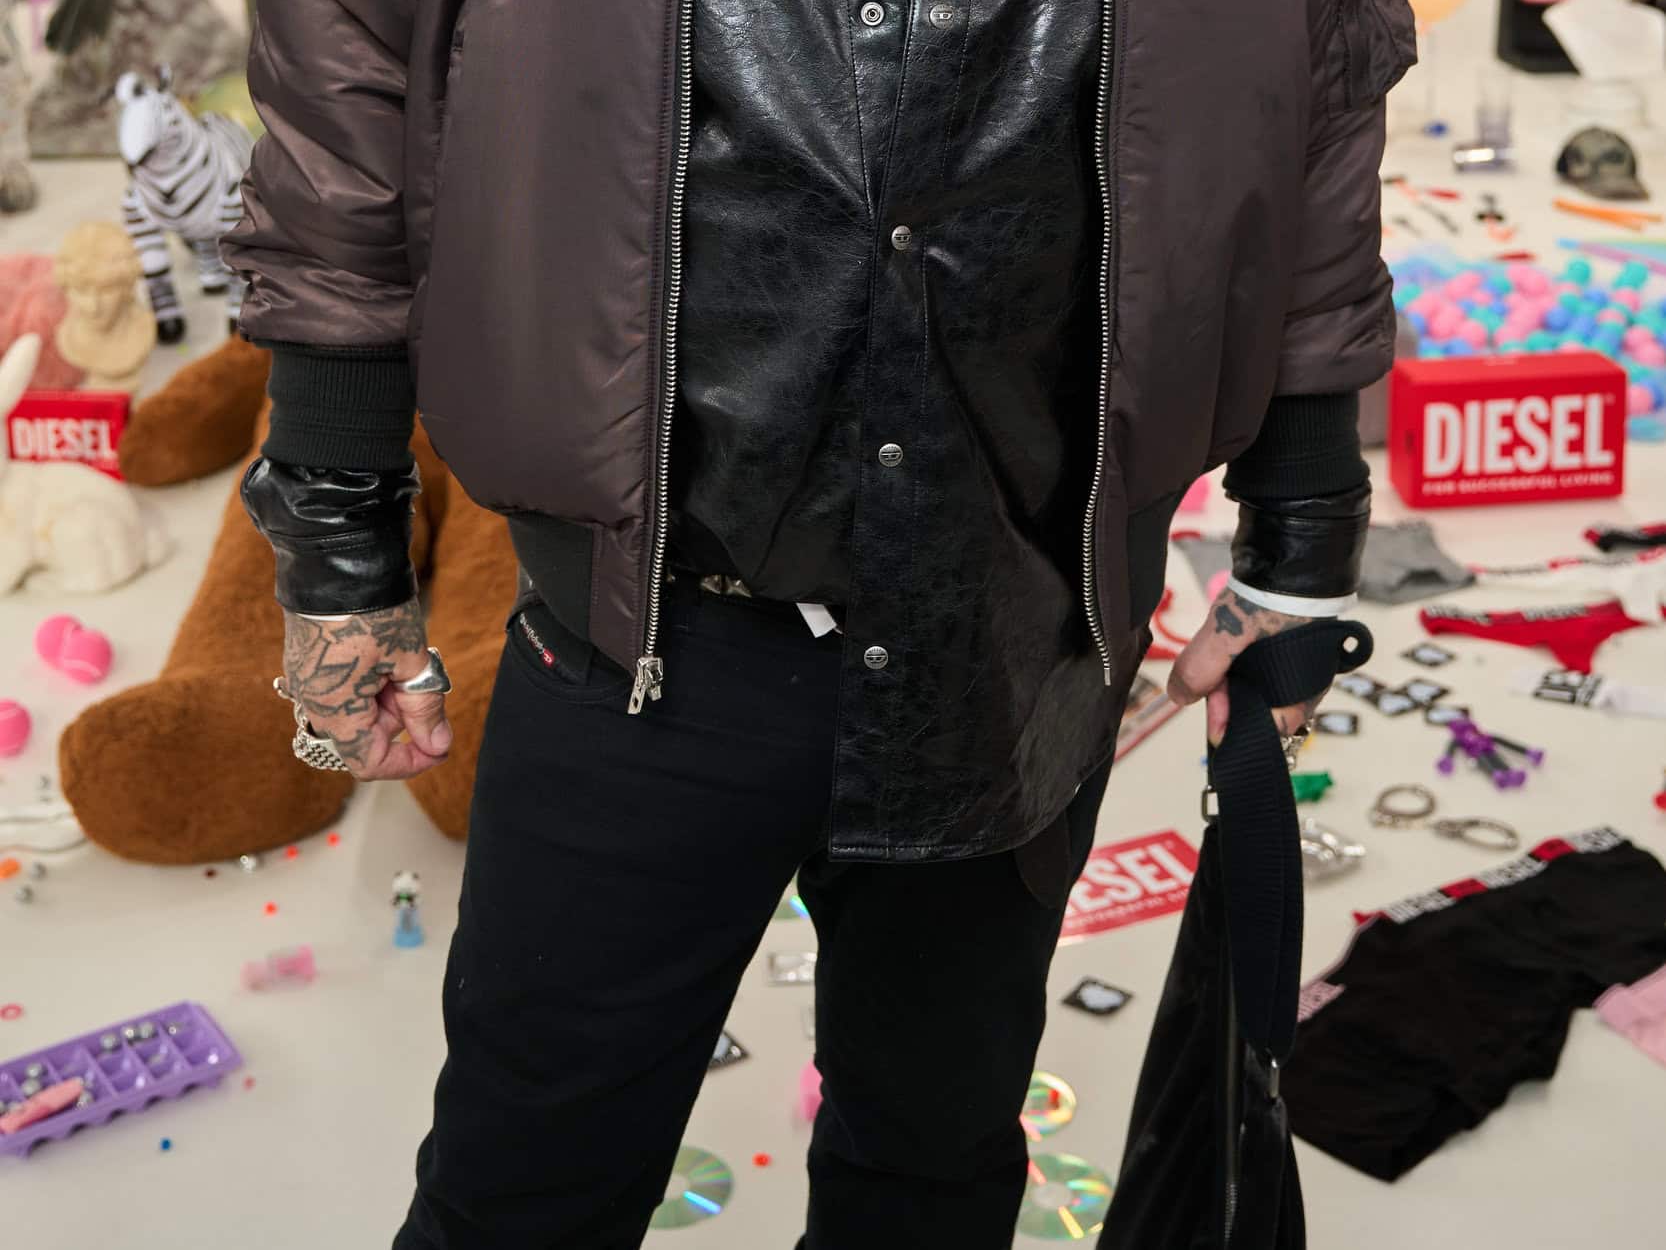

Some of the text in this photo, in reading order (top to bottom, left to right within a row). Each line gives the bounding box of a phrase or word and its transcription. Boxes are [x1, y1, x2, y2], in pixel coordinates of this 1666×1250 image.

[10, 416, 119, 460] DIESEL
[1422, 393, 1615, 478] DIESEL
[1065, 842, 1195, 915] ESEL
